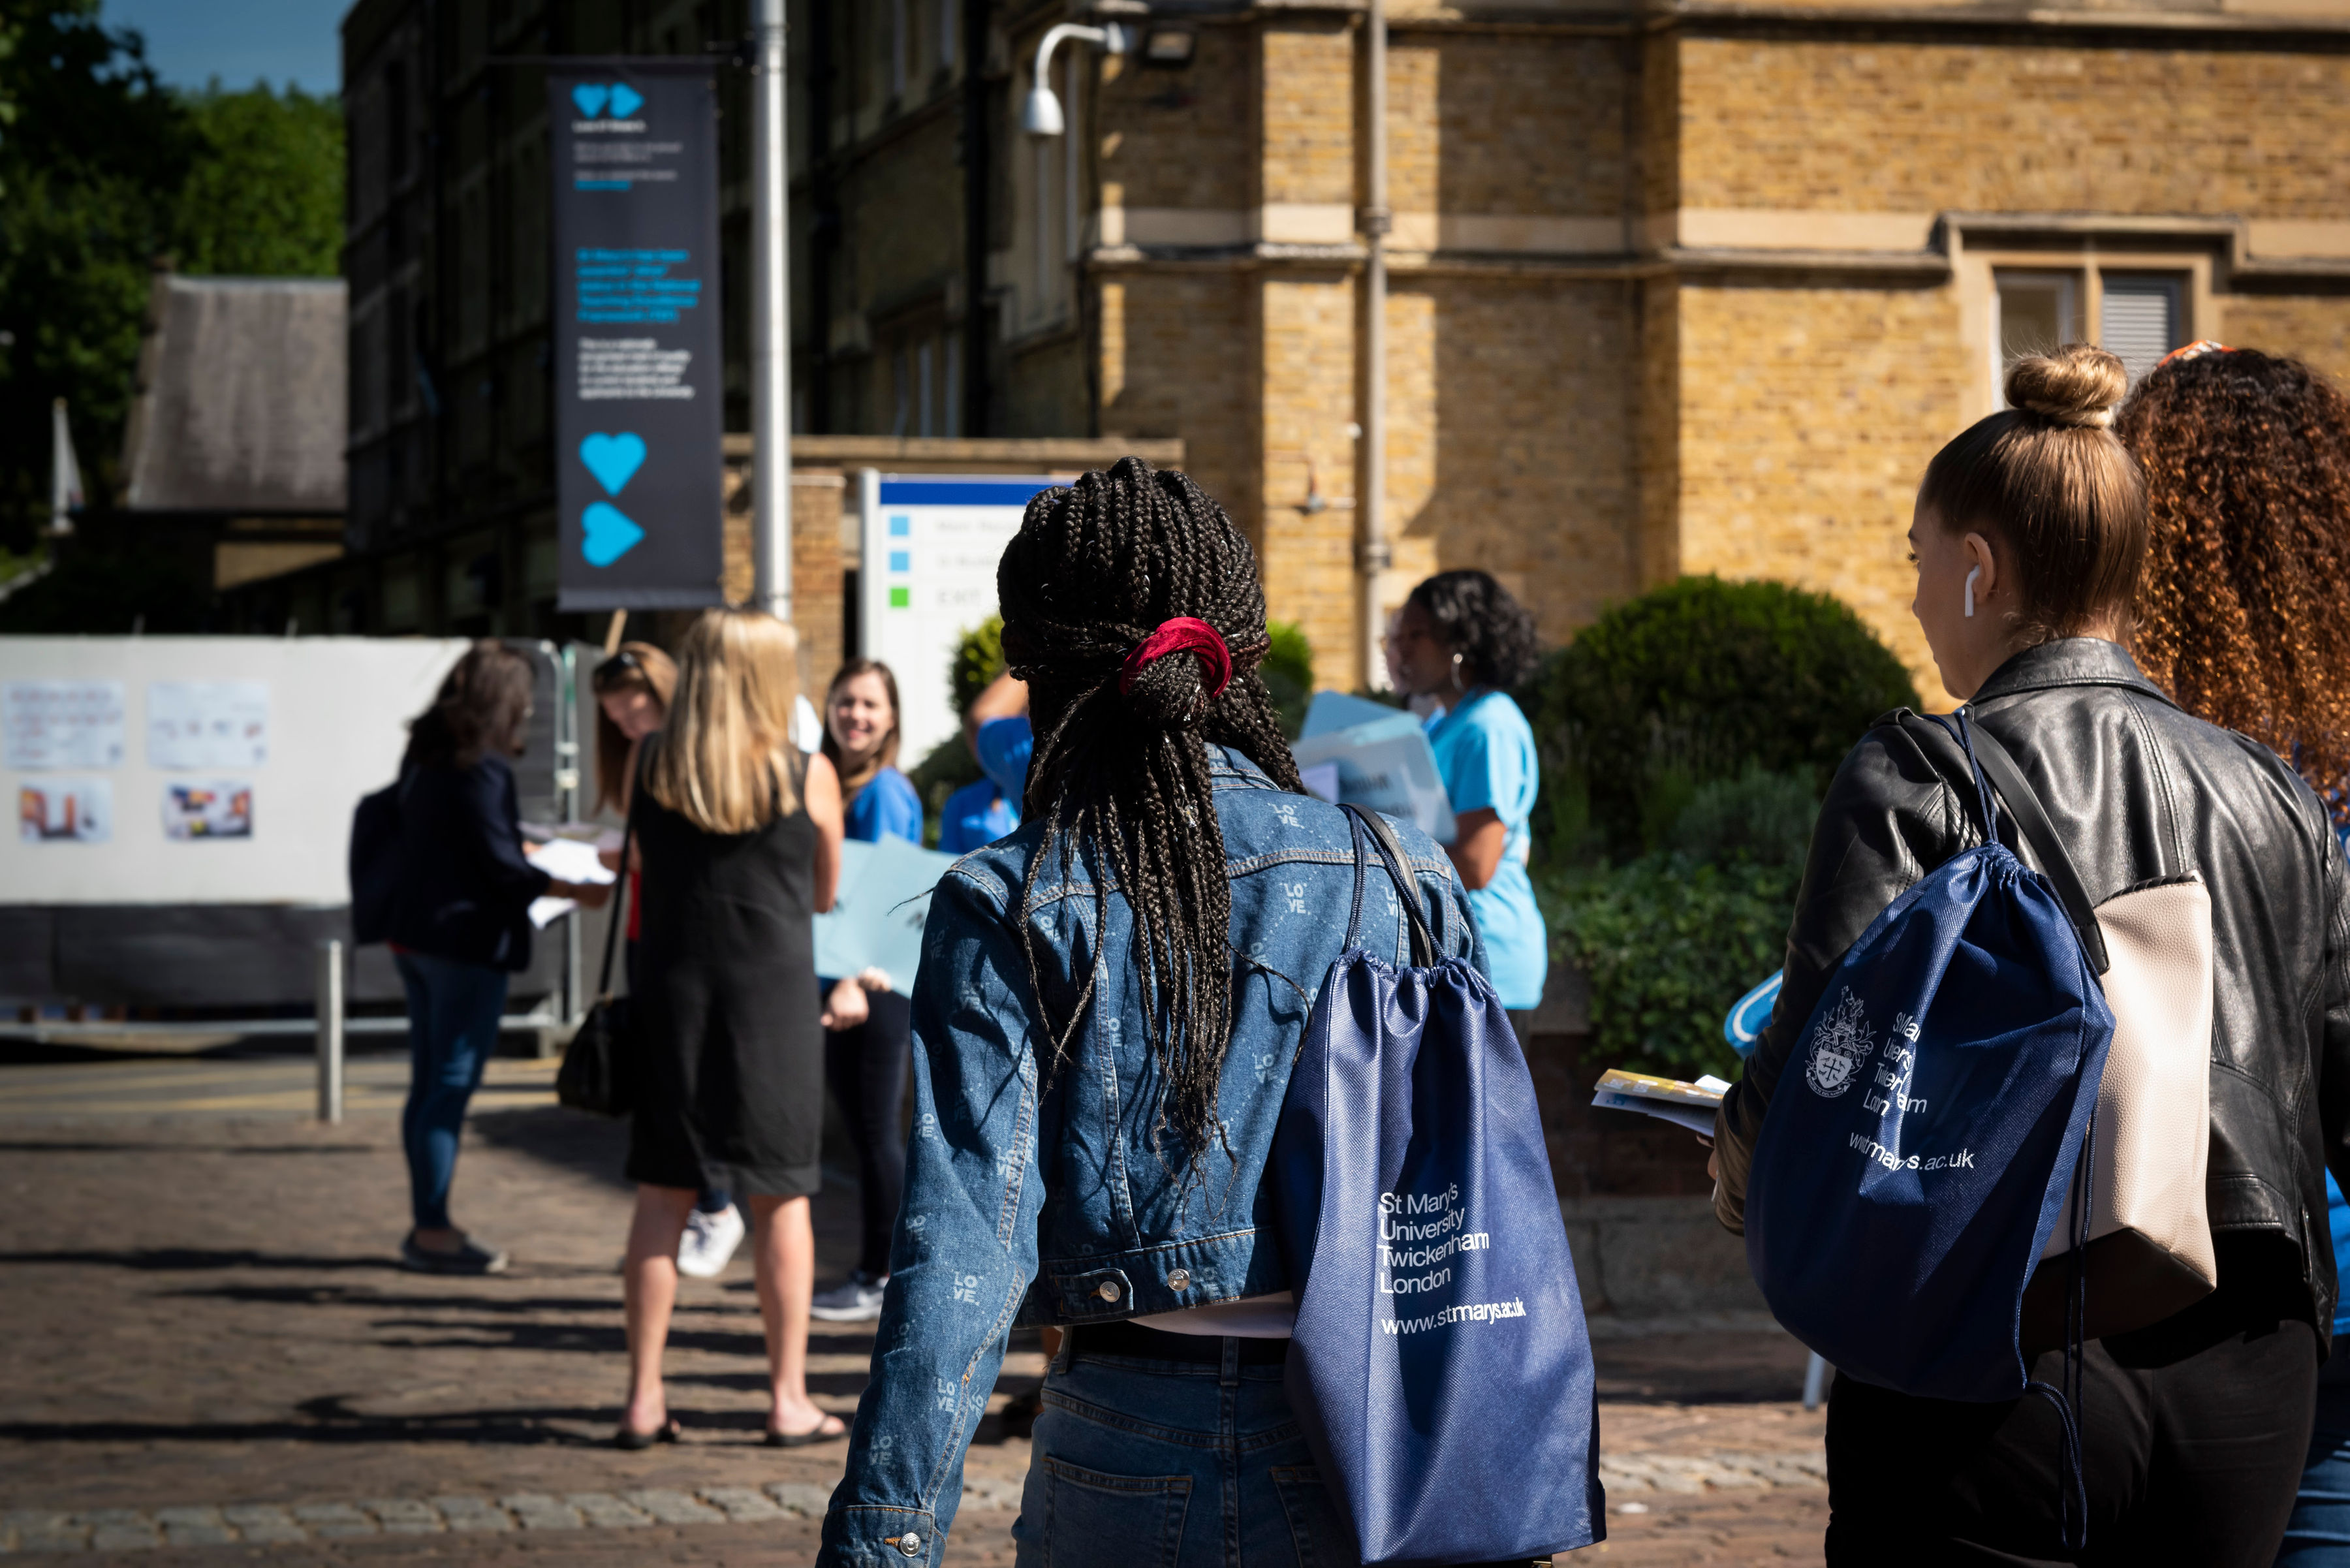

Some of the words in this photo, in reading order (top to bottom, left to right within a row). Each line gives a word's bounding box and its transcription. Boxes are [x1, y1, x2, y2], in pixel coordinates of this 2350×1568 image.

[1380, 1192, 1402, 1214] St
[1407, 1182, 1458, 1214] Mary's
[1380, 1207, 1465, 1241] University
[1377, 1232, 1490, 1267] Twickenham
[1380, 1267, 1450, 1294] London
[1381, 1296, 1526, 1335] www.stmarys.ac.uk
